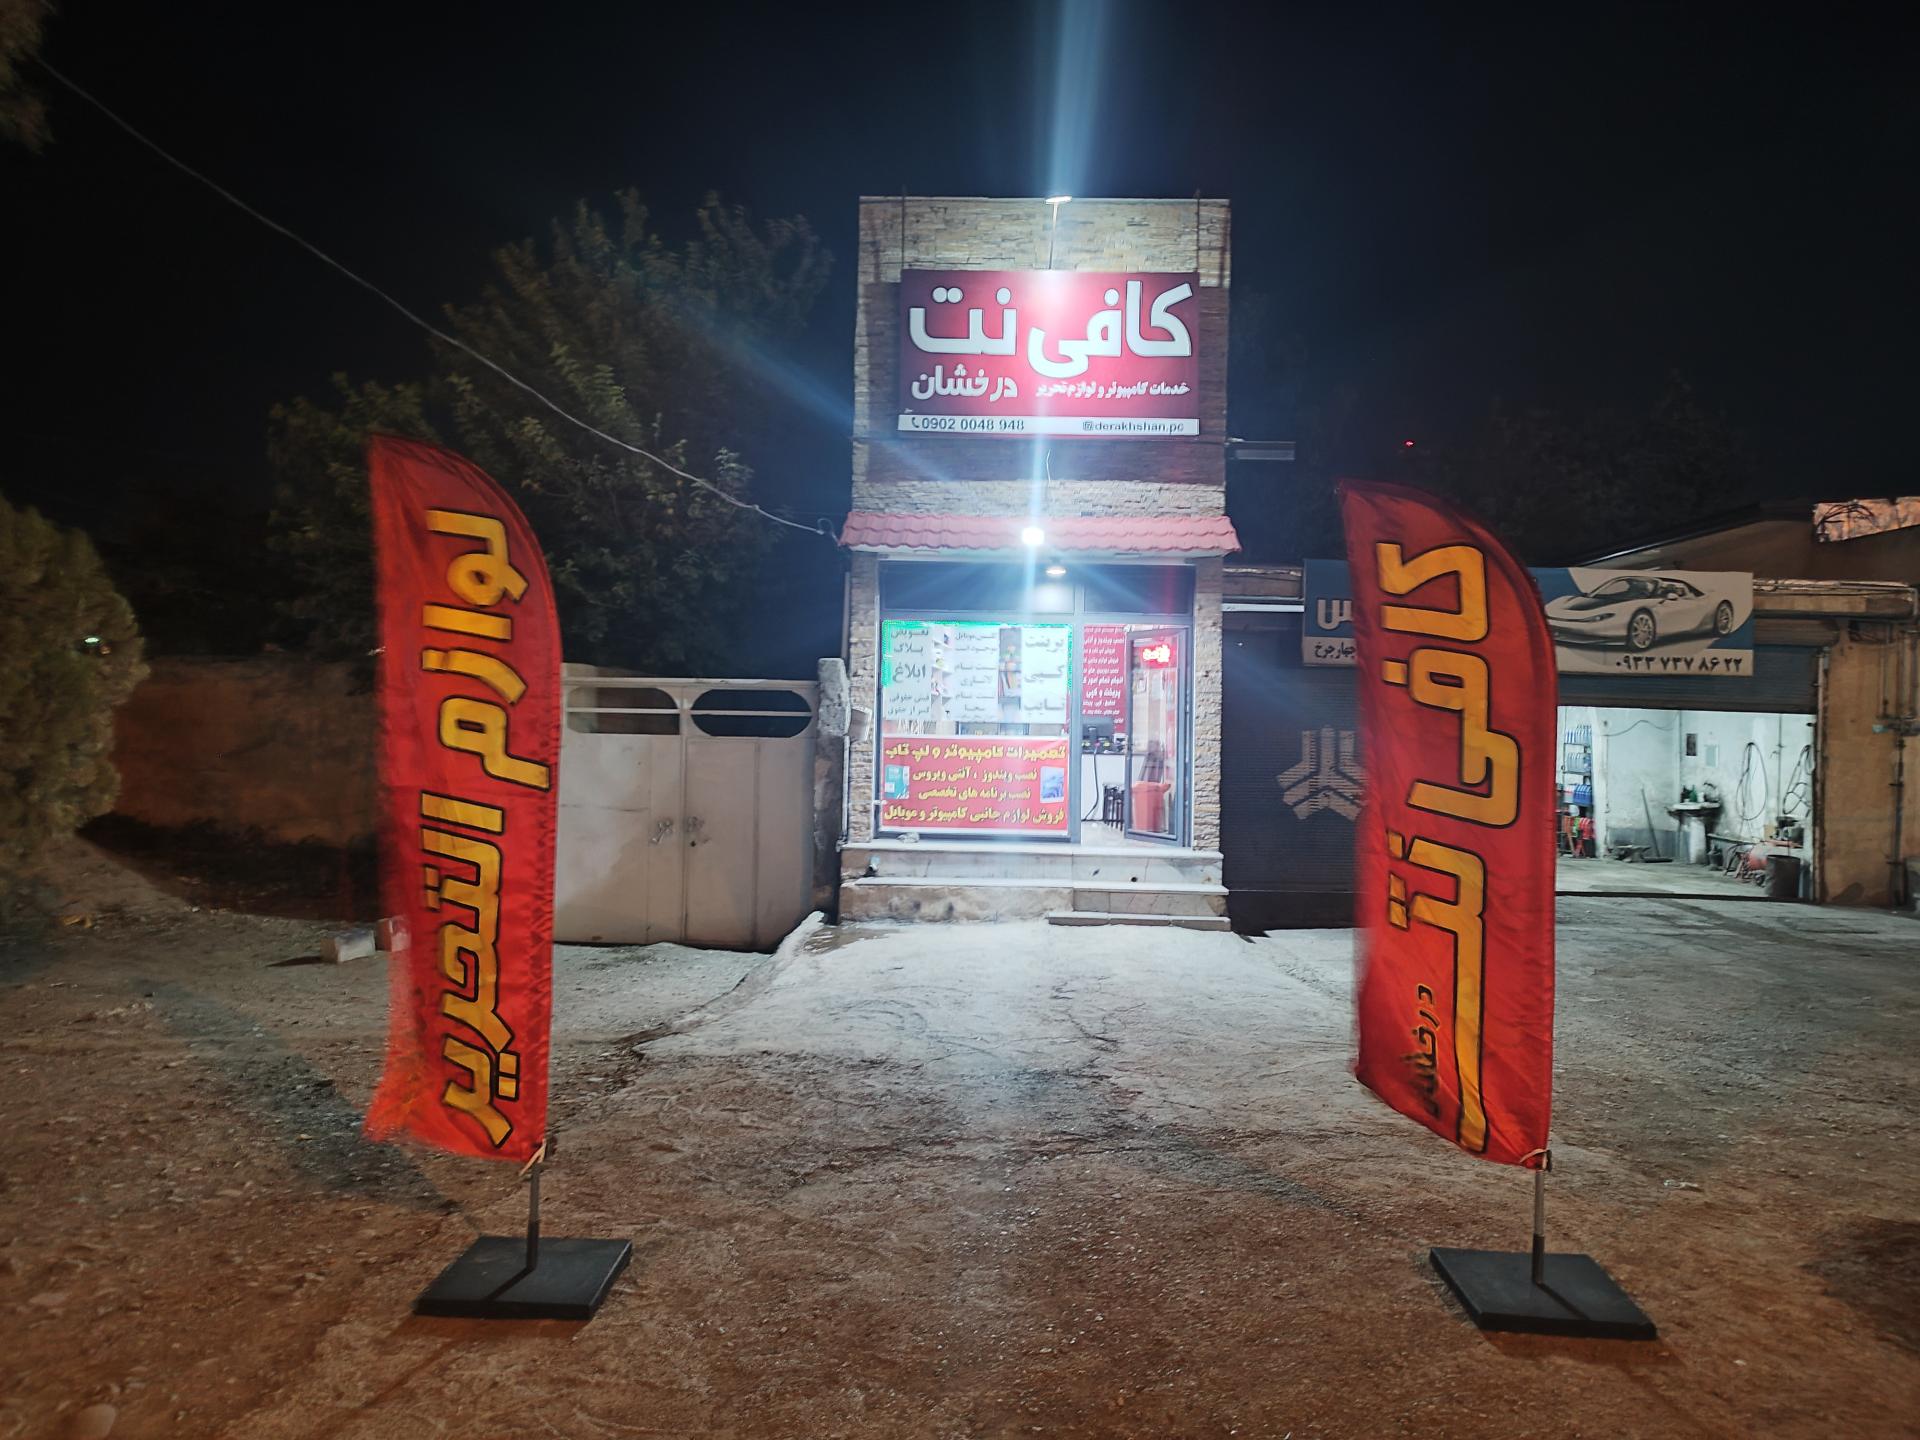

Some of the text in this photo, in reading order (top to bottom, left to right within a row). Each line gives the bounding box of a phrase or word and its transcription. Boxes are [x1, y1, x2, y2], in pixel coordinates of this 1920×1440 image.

[909, 280, 1192, 378] کافی نت
[911, 363, 1018, 401] درخشان
[1066, 381, 1096, 398] لوازم
[1150, 382, 1191, 395] خدمات
[1098, 387, 1105, 398] و
[1106, 381, 1148, 399] کامپیوتر
[922, 418, 1024, 430] 0902 0048 948
[893, 662, 925, 683] ابلاغ
[885, 743, 1066, 763] تعمیرات کامپیوتر و لپ تاپ
[912, 770, 946, 782] ویروس
[948, 766, 971, 781] آنتی
[982, 770, 1013, 783] ویندوز
[1014, 768, 1038, 780] نصب
[918, 786, 957, 800] تخصصی
[958, 787, 978, 800] های
[1008, 787, 1031, 799] نصب
[884, 805, 1065, 825] فروش لوازم جانبی کامپیوتر و موبایل
[420, 509, 551, 1148] لوازم التحریر
[1376, 542, 1519, 1152] کافی نت
